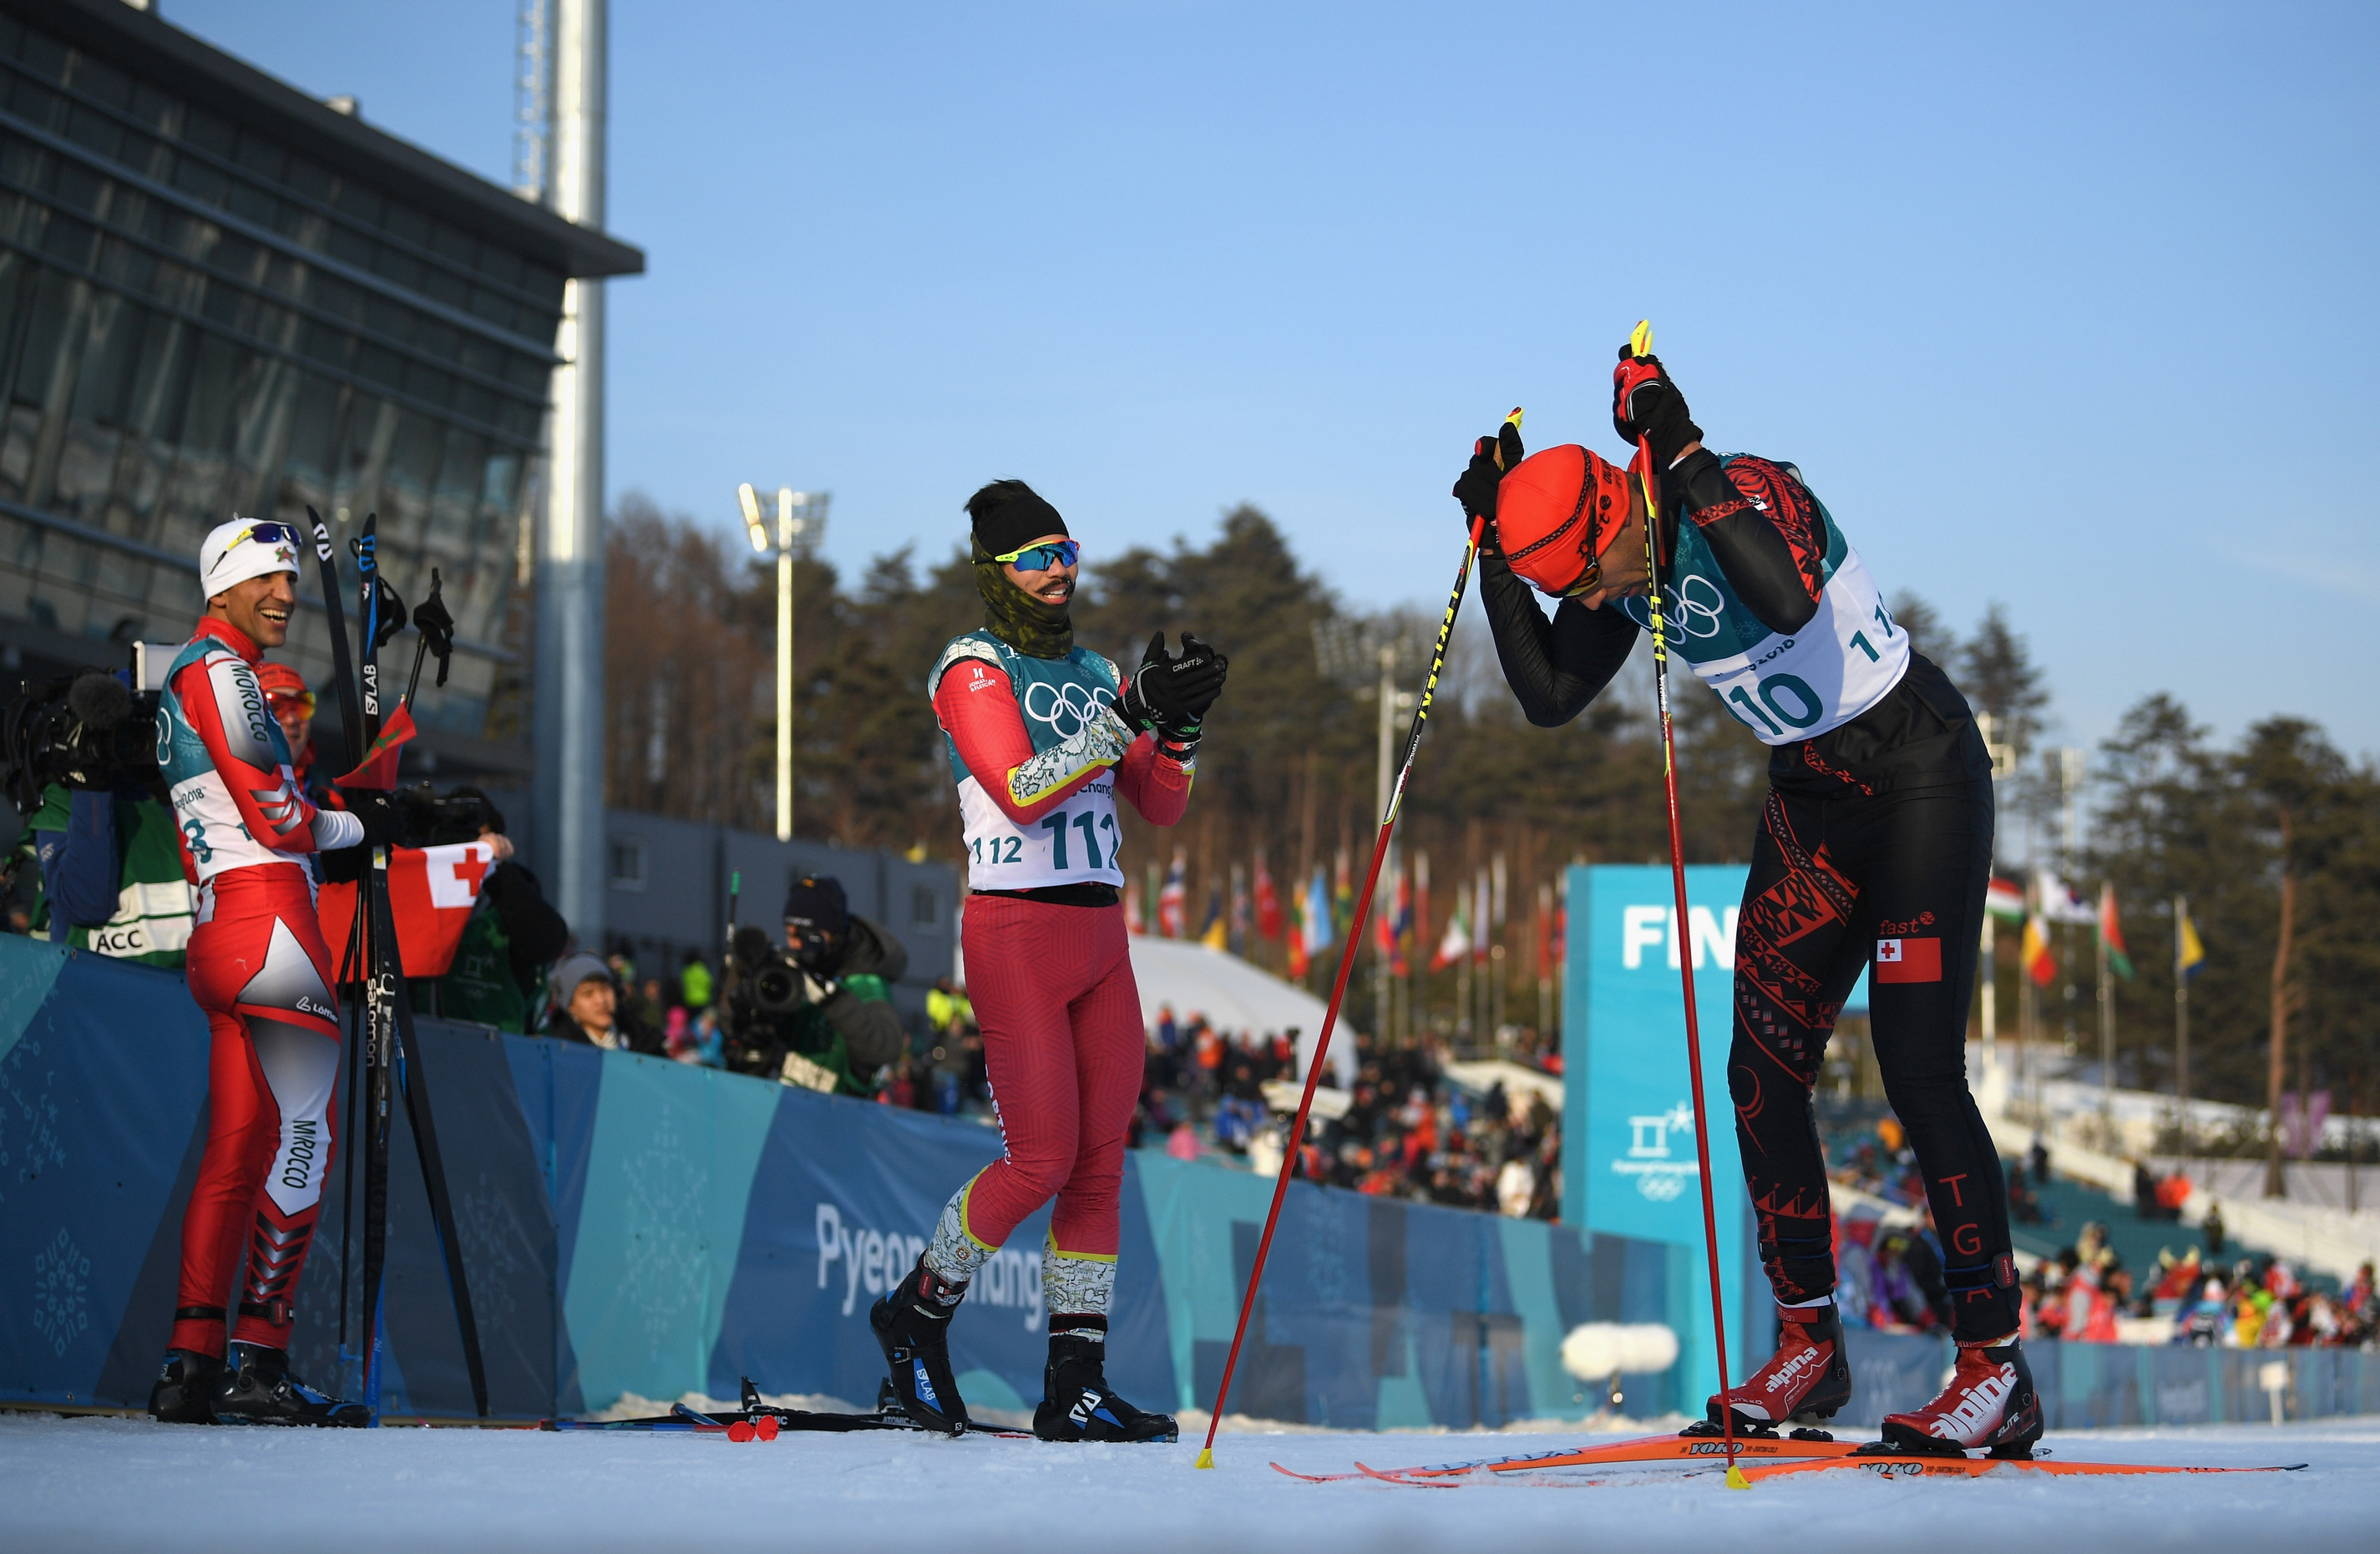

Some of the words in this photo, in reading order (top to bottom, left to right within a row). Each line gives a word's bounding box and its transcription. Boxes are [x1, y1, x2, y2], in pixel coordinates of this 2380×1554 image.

[1577, 511, 1611, 560] fst
[1649, 595, 1666, 662] LEKI
[1172, 660, 1196, 672] CRAFT
[230, 663, 268, 742] MOROCCO
[1418, 657, 1444, 721] LEKI
[972, 836, 1022, 864] 112
[1879, 919, 1920, 935] fast
[96, 929, 143, 953] ACC
[282, 1120, 317, 1189] MROCCO
[1765, 1346, 1819, 1393] alpina
[1930, 1361, 2018, 1440] alpina
[748, 1415, 788, 1425] ATIC
[882, 1416, 909, 1425] ATOMIC
[1997, 1411, 2020, 1438] ELITE
[1689, 1442, 1744, 1455] YOKO
[1859, 1462, 1924, 1476] YOKO
